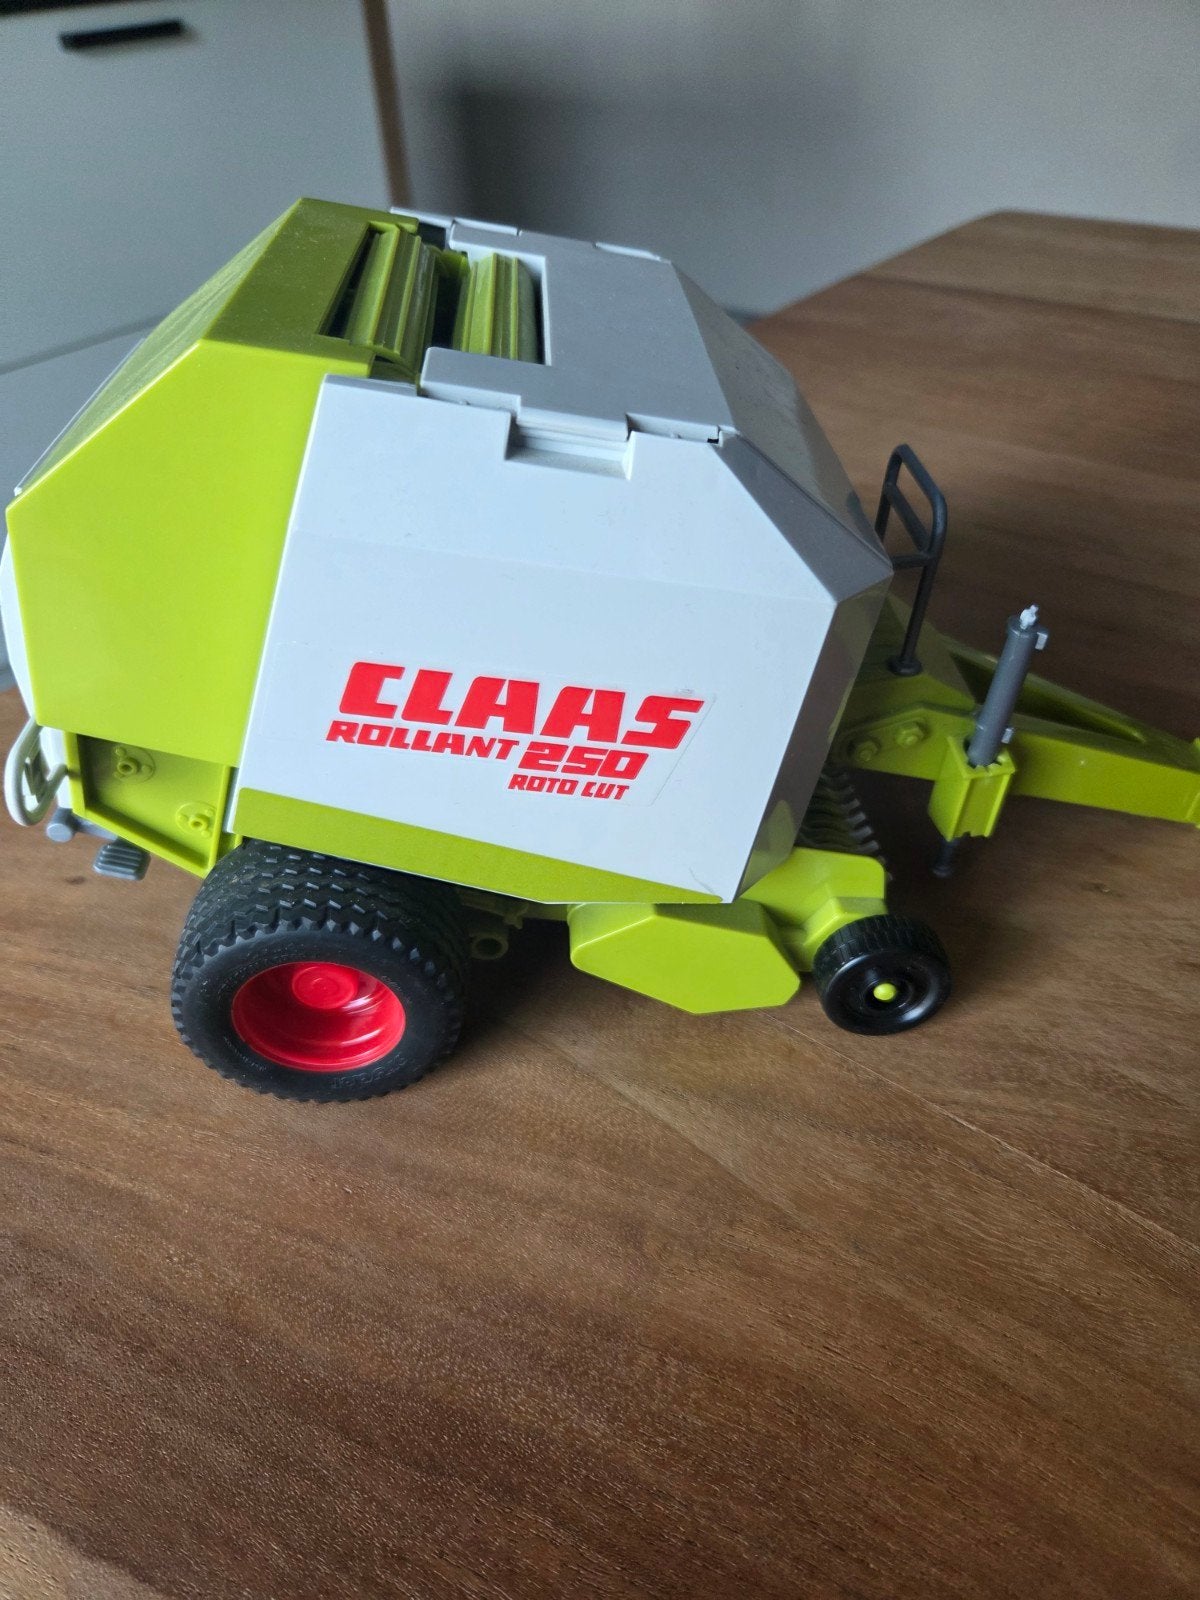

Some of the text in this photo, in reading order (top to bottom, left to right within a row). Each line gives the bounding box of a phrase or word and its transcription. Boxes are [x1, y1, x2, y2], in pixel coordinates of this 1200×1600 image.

[339, 661, 704, 749] CLAAS
[326, 720, 649, 780] ROLLANT 250
[508, 773, 630, 800] ROTO CUT
